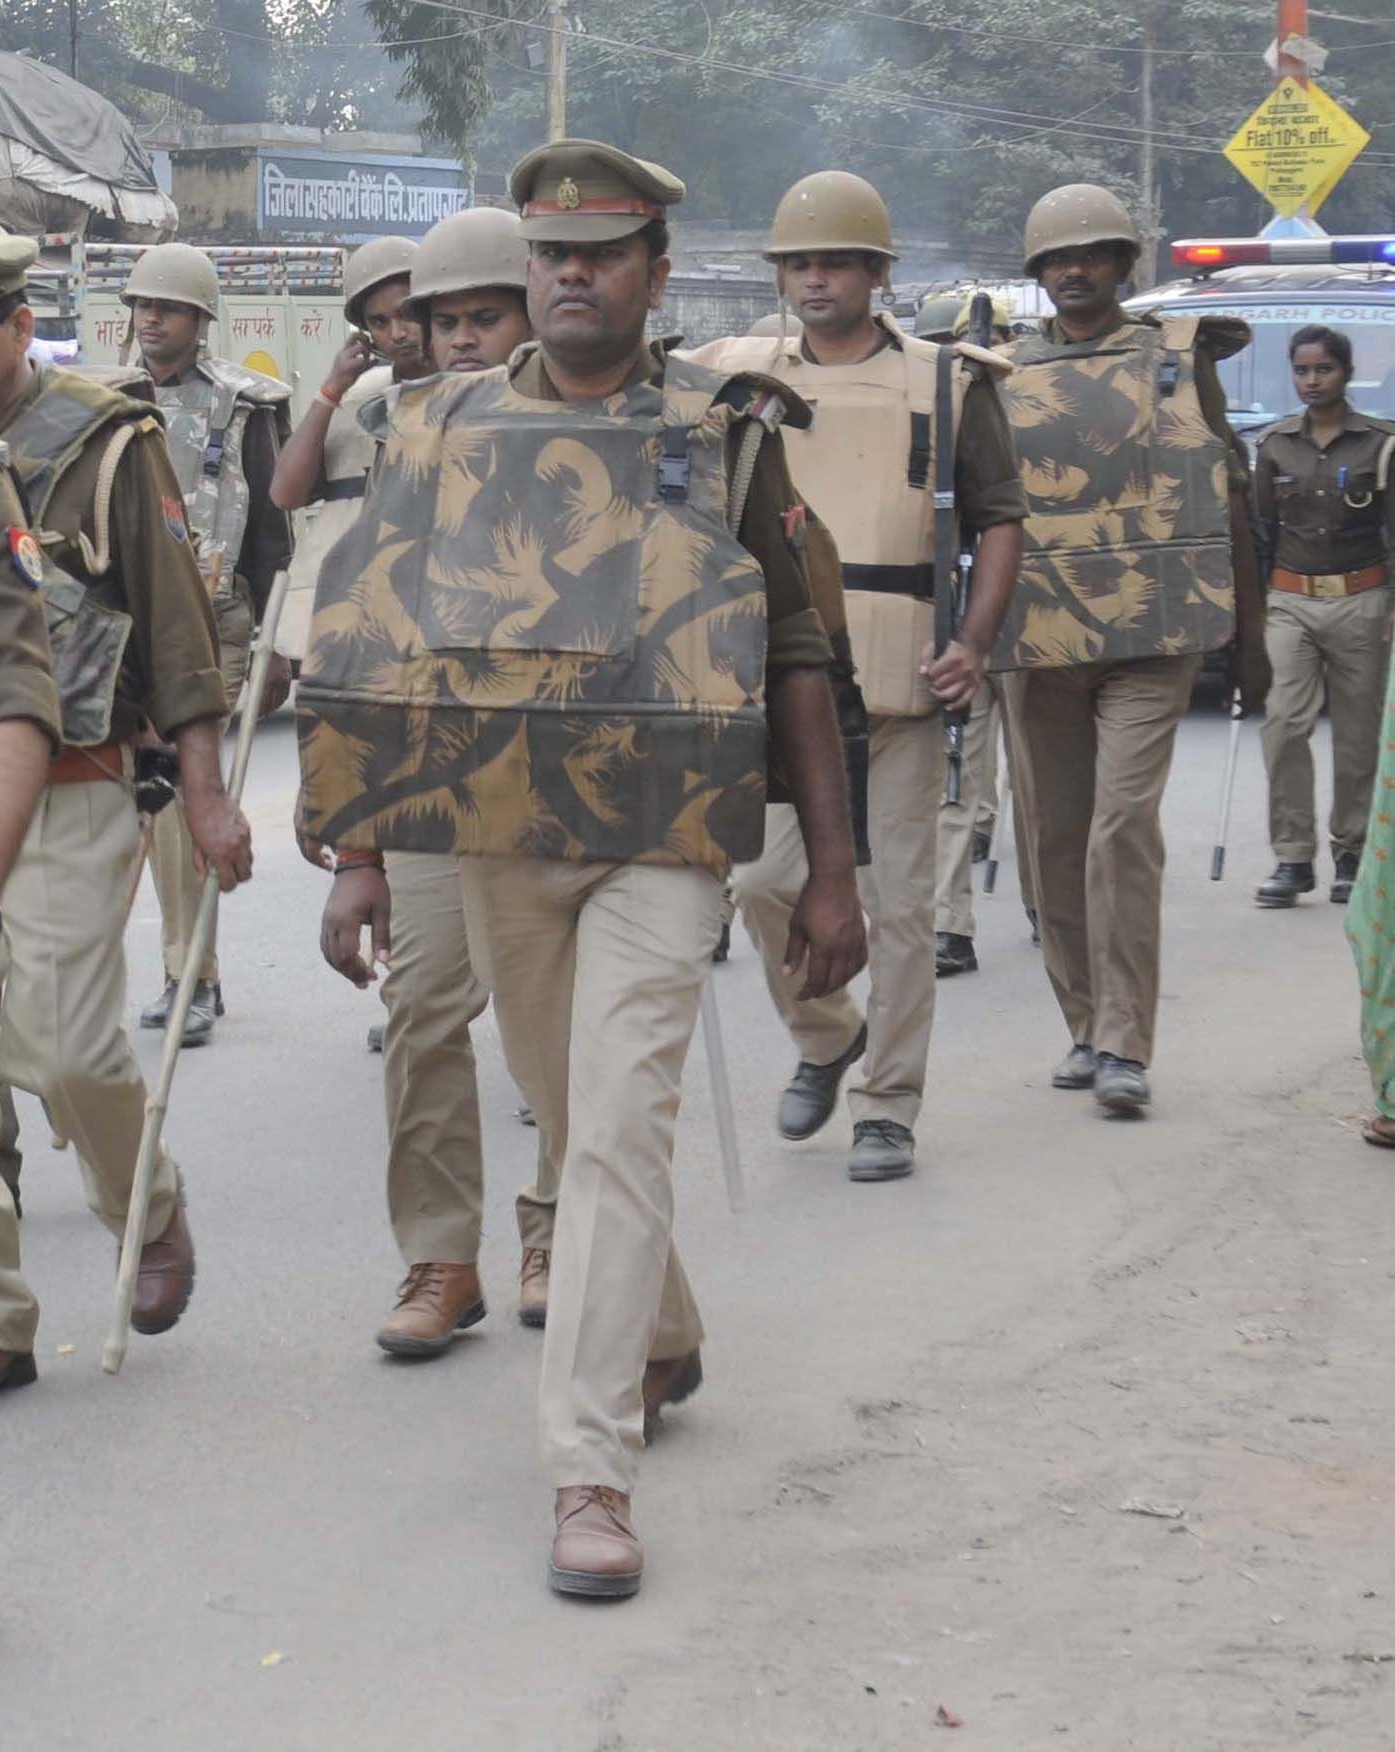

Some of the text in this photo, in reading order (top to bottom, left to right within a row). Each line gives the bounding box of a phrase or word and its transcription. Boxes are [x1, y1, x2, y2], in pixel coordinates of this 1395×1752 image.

[1247, 130, 1272, 147] Flat
[1275, 128, 1306, 146] 10%
[264, 162, 303, 217] जिला
[304, 169, 359, 221] सहकारी
